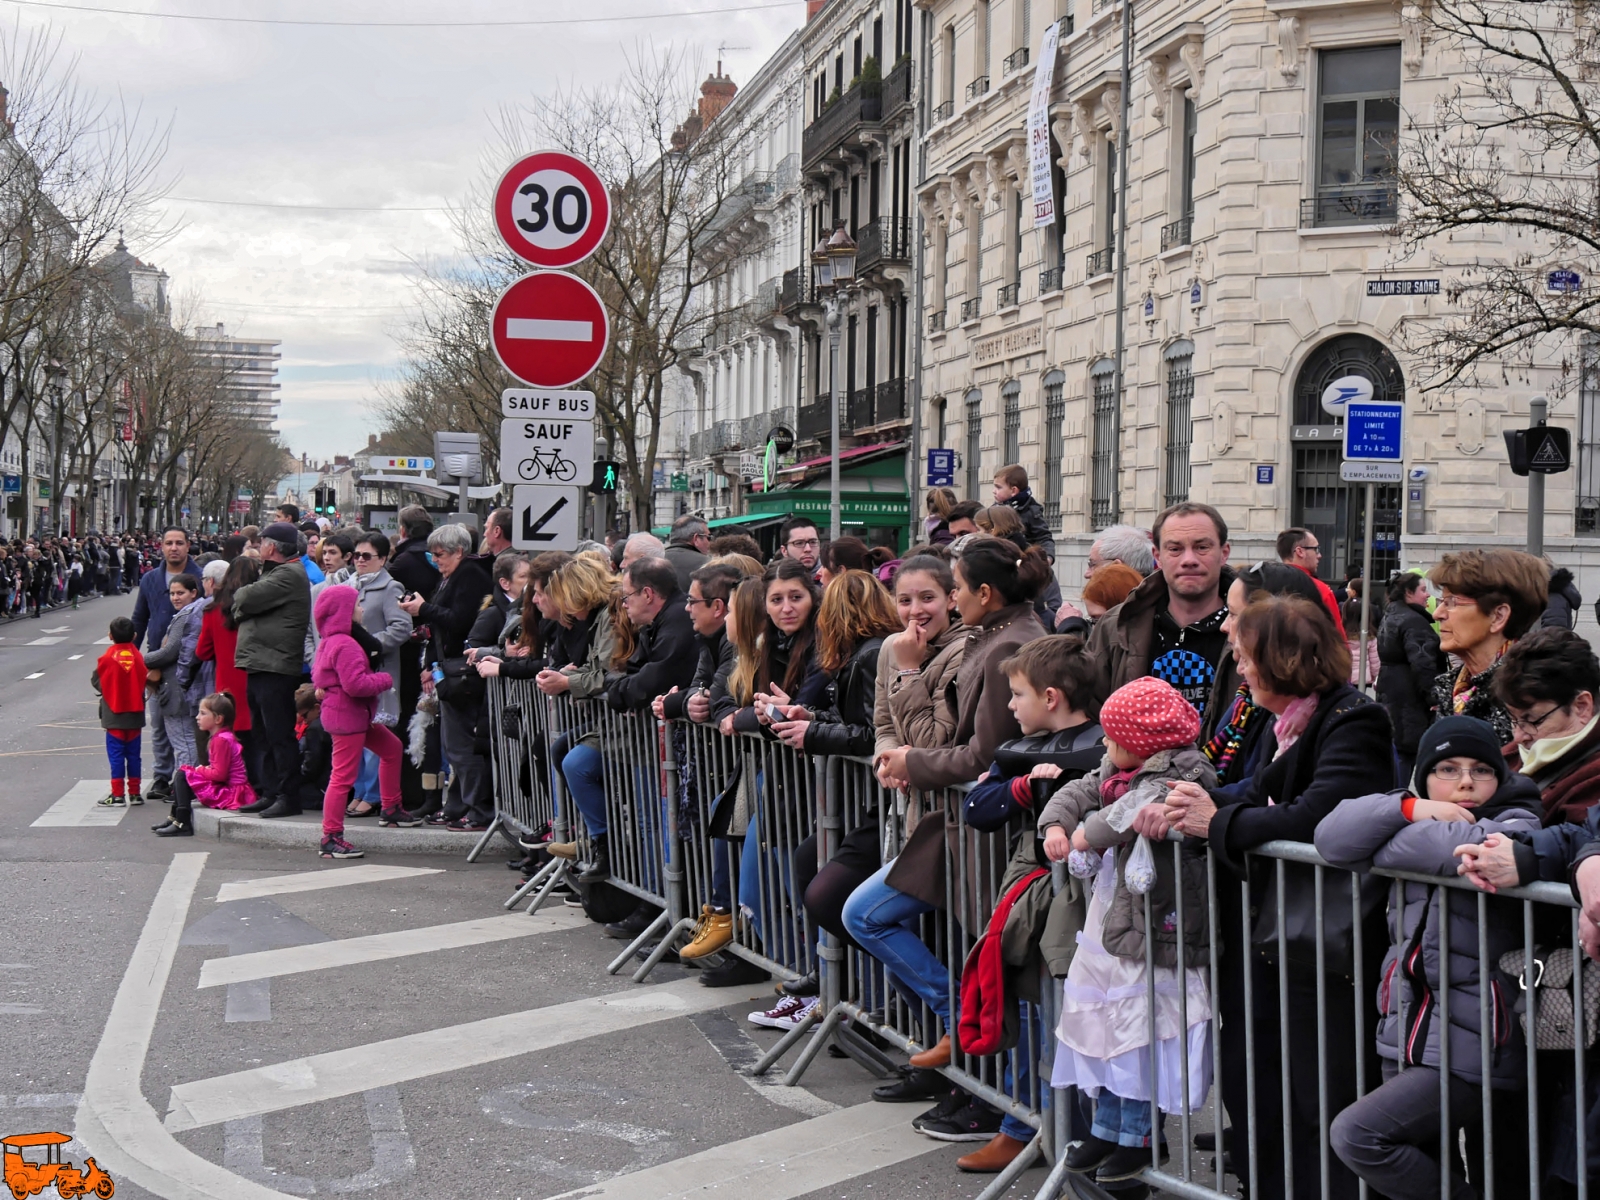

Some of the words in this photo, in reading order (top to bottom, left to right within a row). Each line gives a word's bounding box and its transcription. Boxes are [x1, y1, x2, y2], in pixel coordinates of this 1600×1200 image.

[517, 183, 588, 235] 30
[508, 396, 551, 411] SAUF
[558, 398, 589, 412] BUS
[1350, 410, 1400, 418] STATIONNEMENT
[524, 423, 573, 440] SAUF
[1295, 428, 1319, 438] LA
[400, 459, 405, 467] 4
[855, 504, 879, 512] PIZZA
[881, 504, 909, 513] PAOLO
